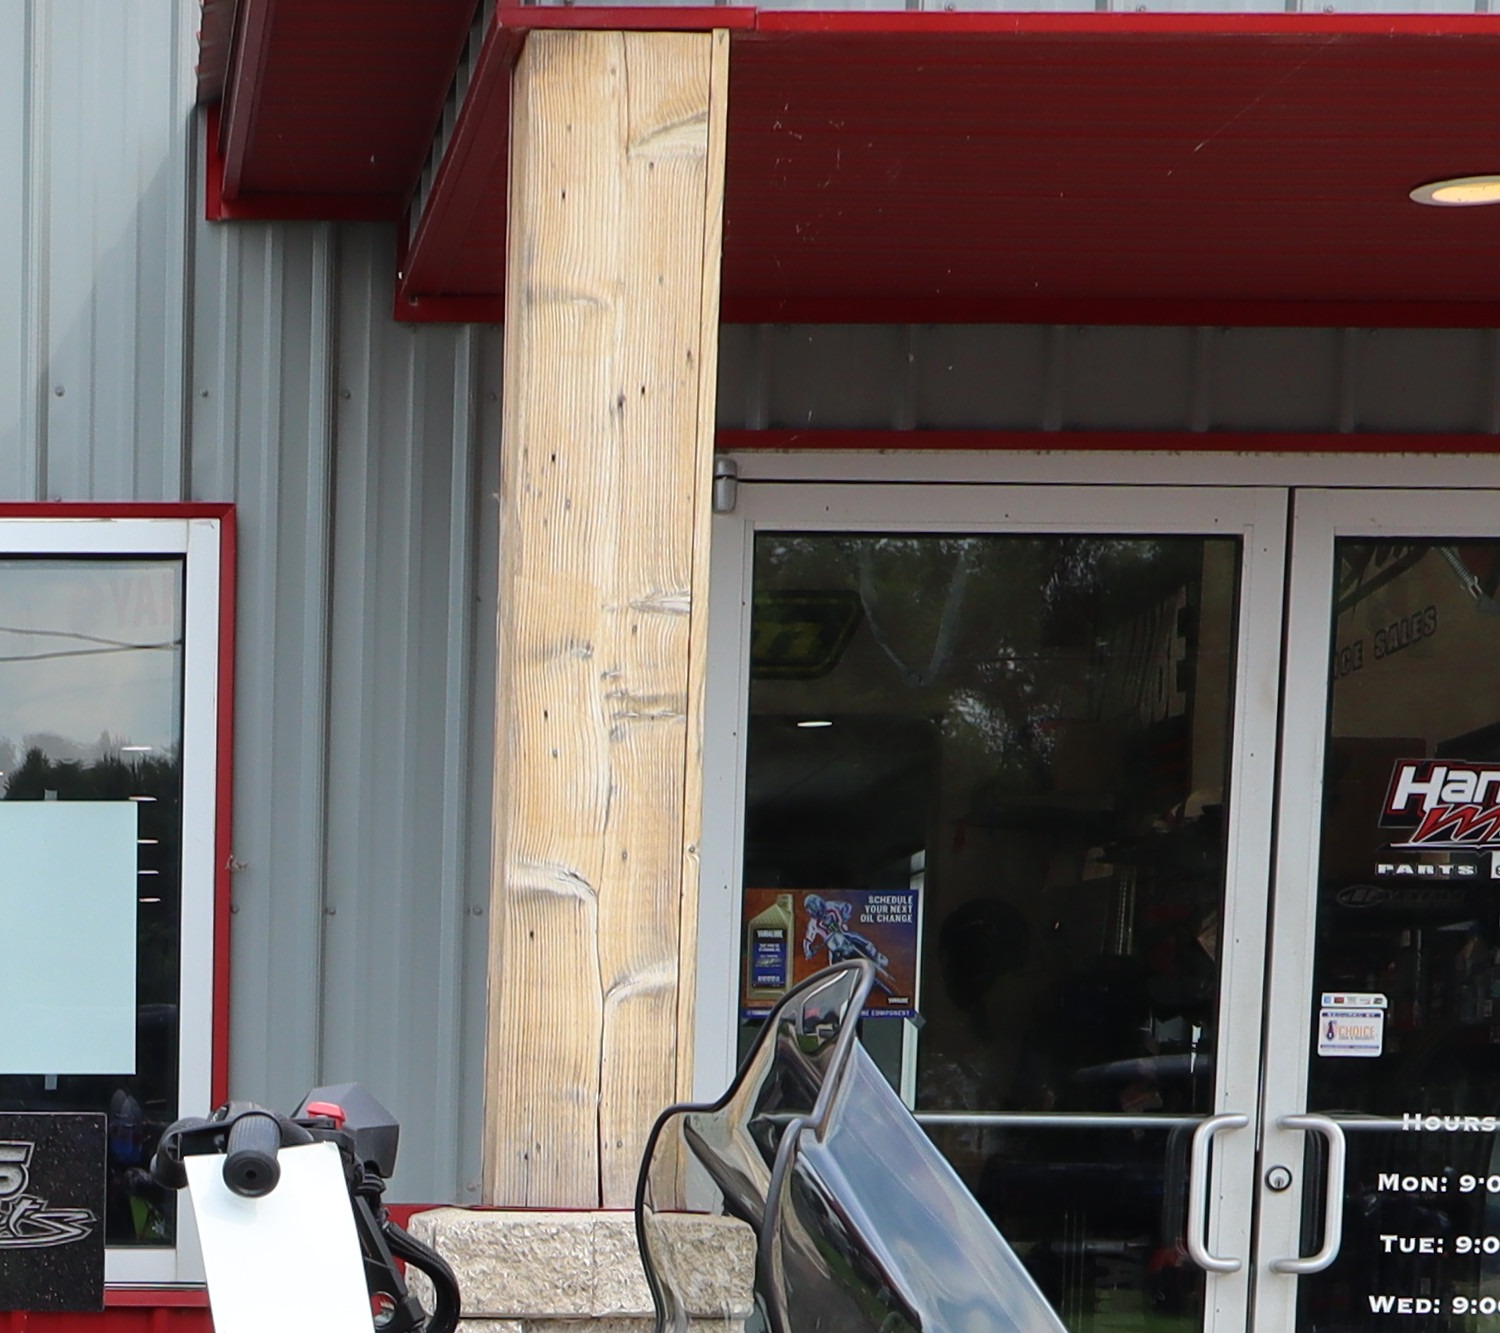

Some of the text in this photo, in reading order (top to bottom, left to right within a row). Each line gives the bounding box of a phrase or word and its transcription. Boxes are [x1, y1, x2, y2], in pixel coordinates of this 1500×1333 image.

[1377, 863, 1478, 877] PARTS
[868, 895, 914, 905] SCHEDULE
[864, 904, 914, 914] YOUR NEXT
[860, 914, 913, 923] OIL CHANGE
[1339, 1025, 1376, 1037] CHOICE
